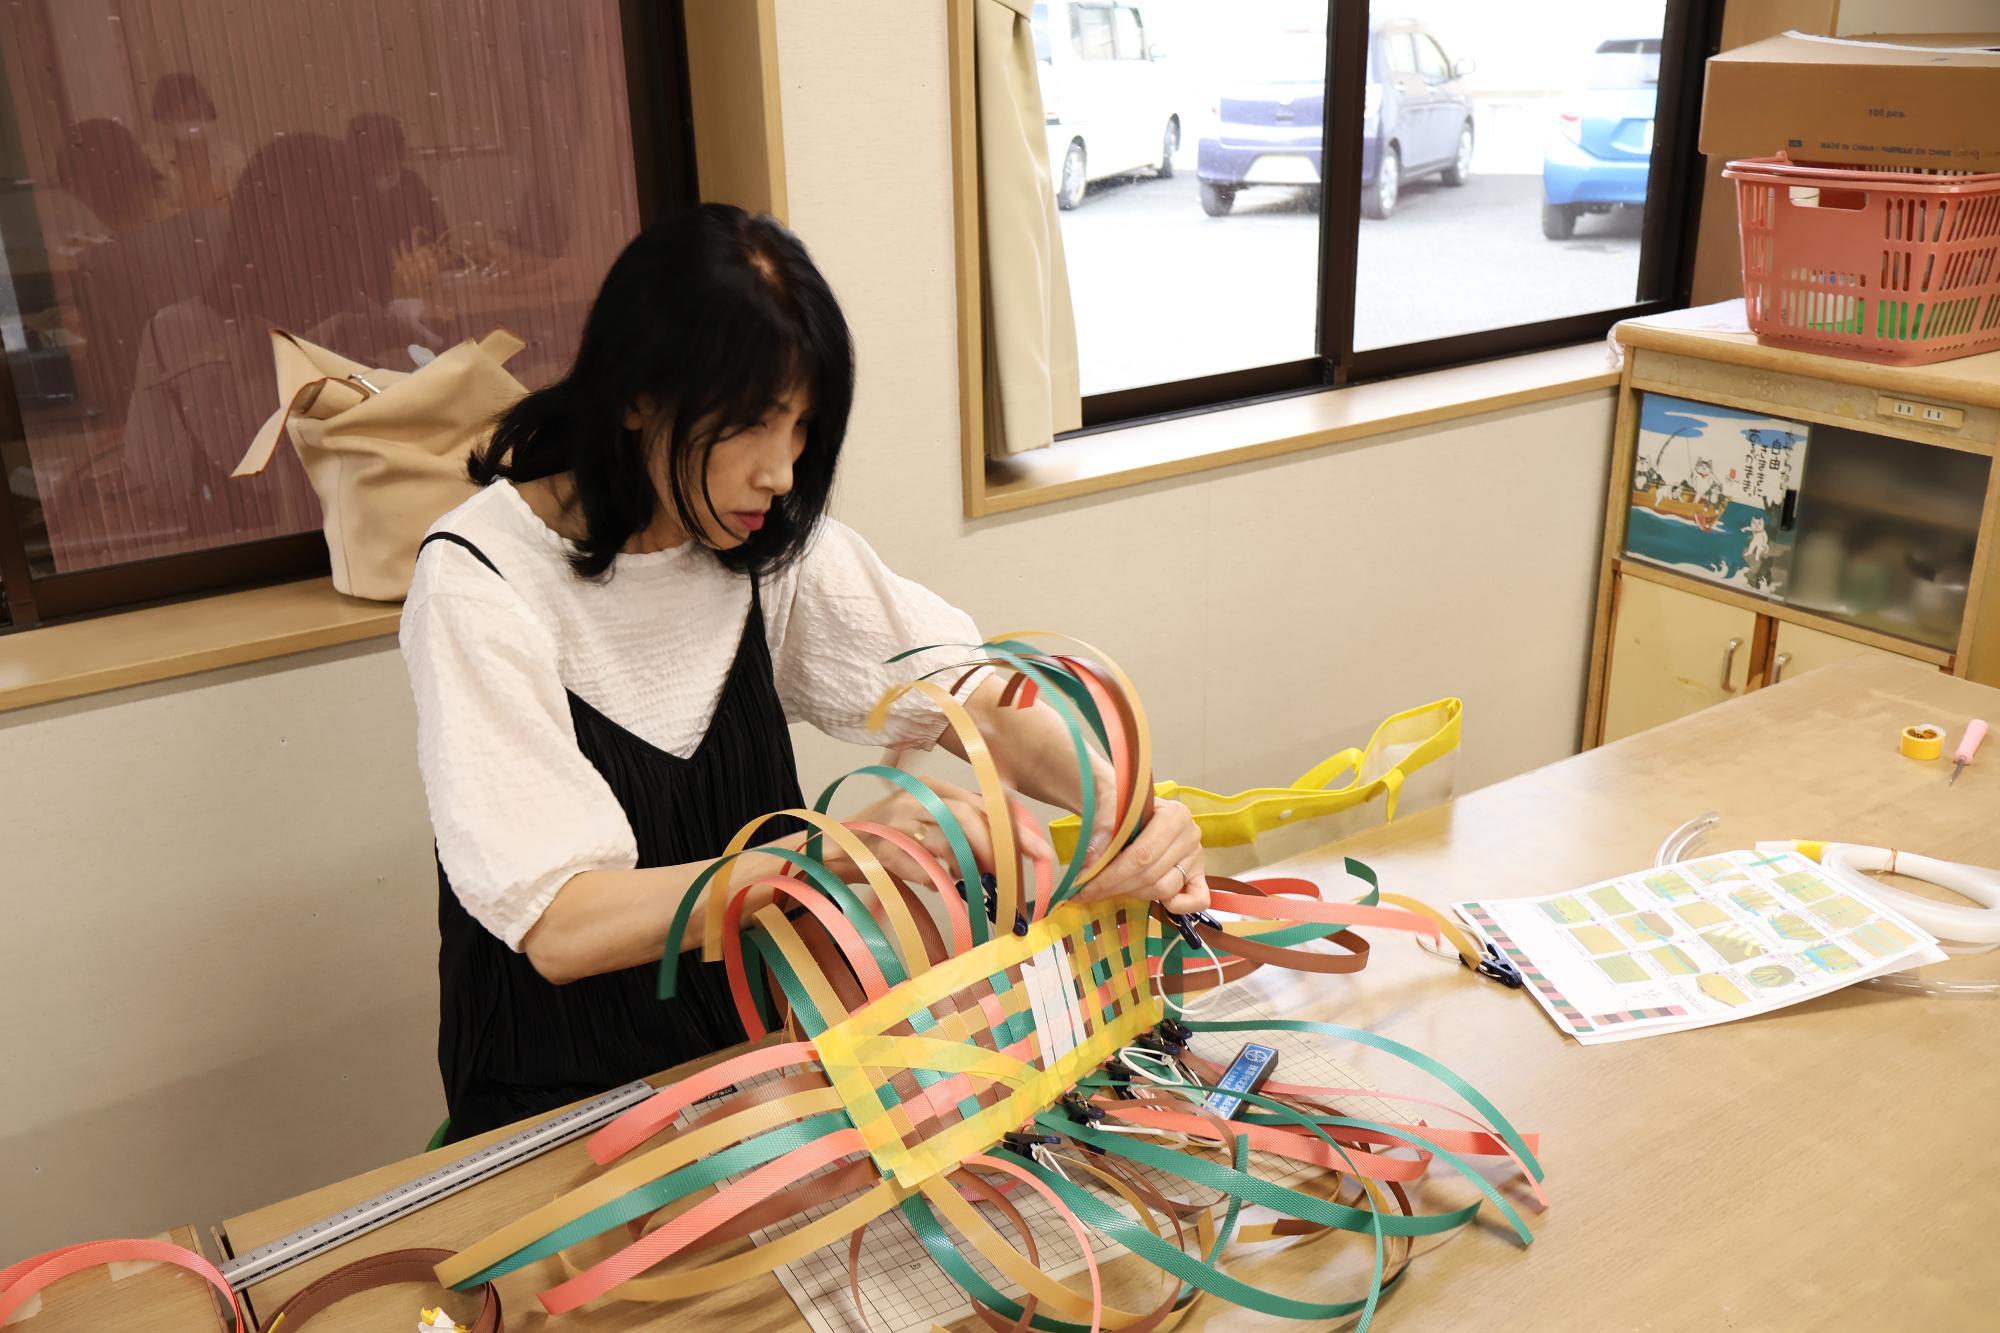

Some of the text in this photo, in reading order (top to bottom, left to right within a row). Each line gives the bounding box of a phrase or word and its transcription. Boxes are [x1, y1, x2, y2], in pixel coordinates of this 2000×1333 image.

[1868, 108, 1906, 119] 100 pcs.
[1820, 142, 1840, 150] MADE
[1852, 143, 1874, 152] CHINA
[1928, 149, 1953, 157] CHINE
